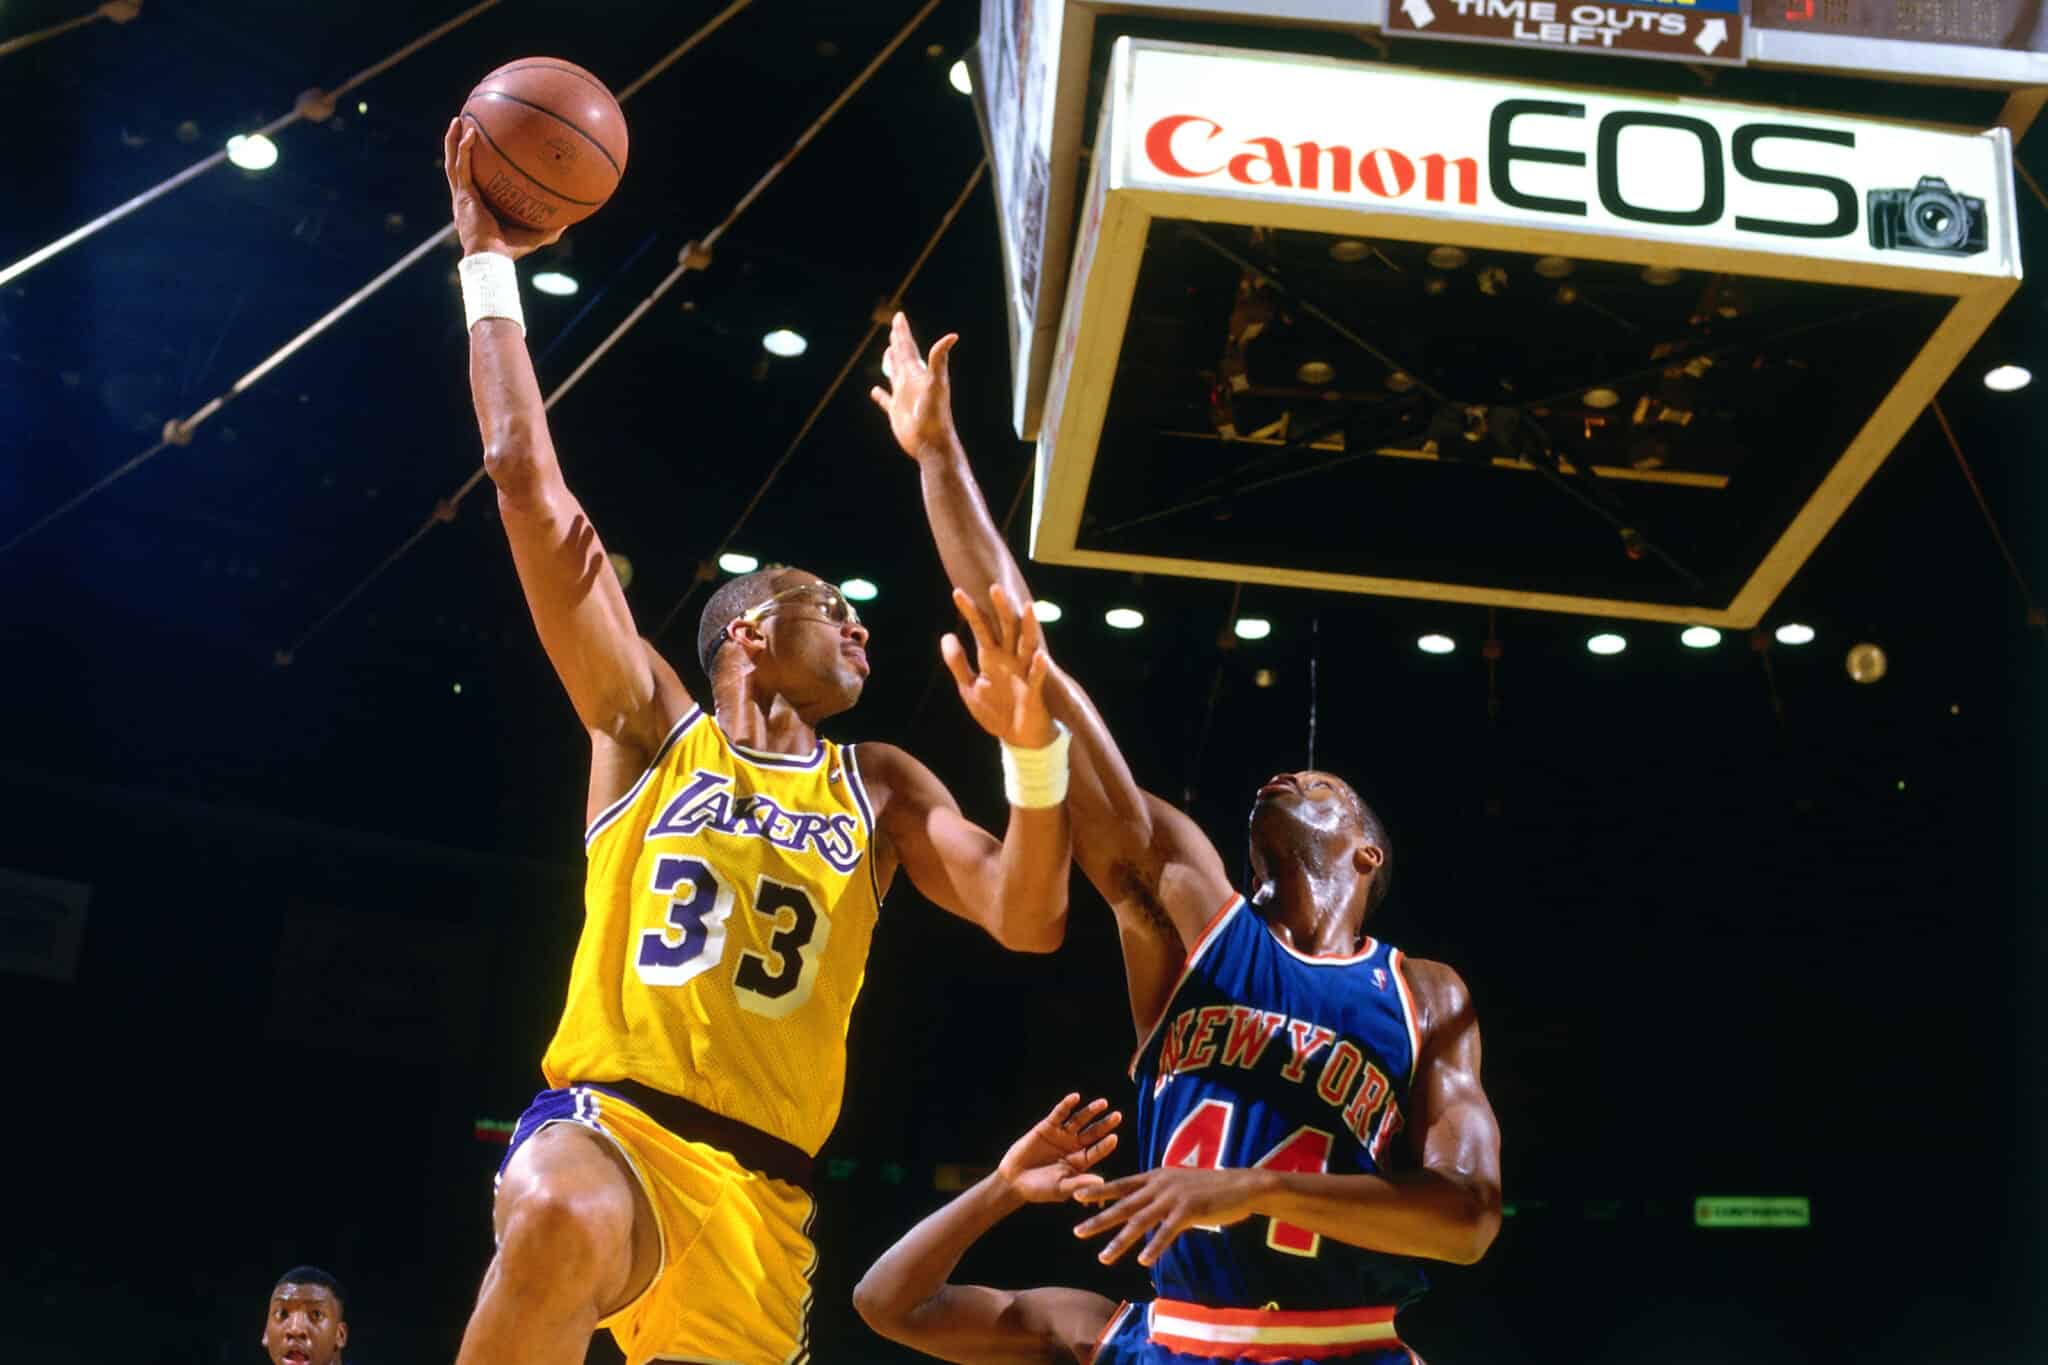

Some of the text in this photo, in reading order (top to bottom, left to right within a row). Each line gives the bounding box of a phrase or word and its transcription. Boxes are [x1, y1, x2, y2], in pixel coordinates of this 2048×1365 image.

[1450, 0, 1687, 36] TIME OUTS
[1513, 20, 1622, 48] LEFT
[1146, 99, 1860, 238] Canon EOS
[645, 769, 863, 872] LAKERS
[636, 854, 831, 1019] 33
[1154, 1004, 1287, 1099] NEW
[1161, 1098, 1335, 1258] 44
